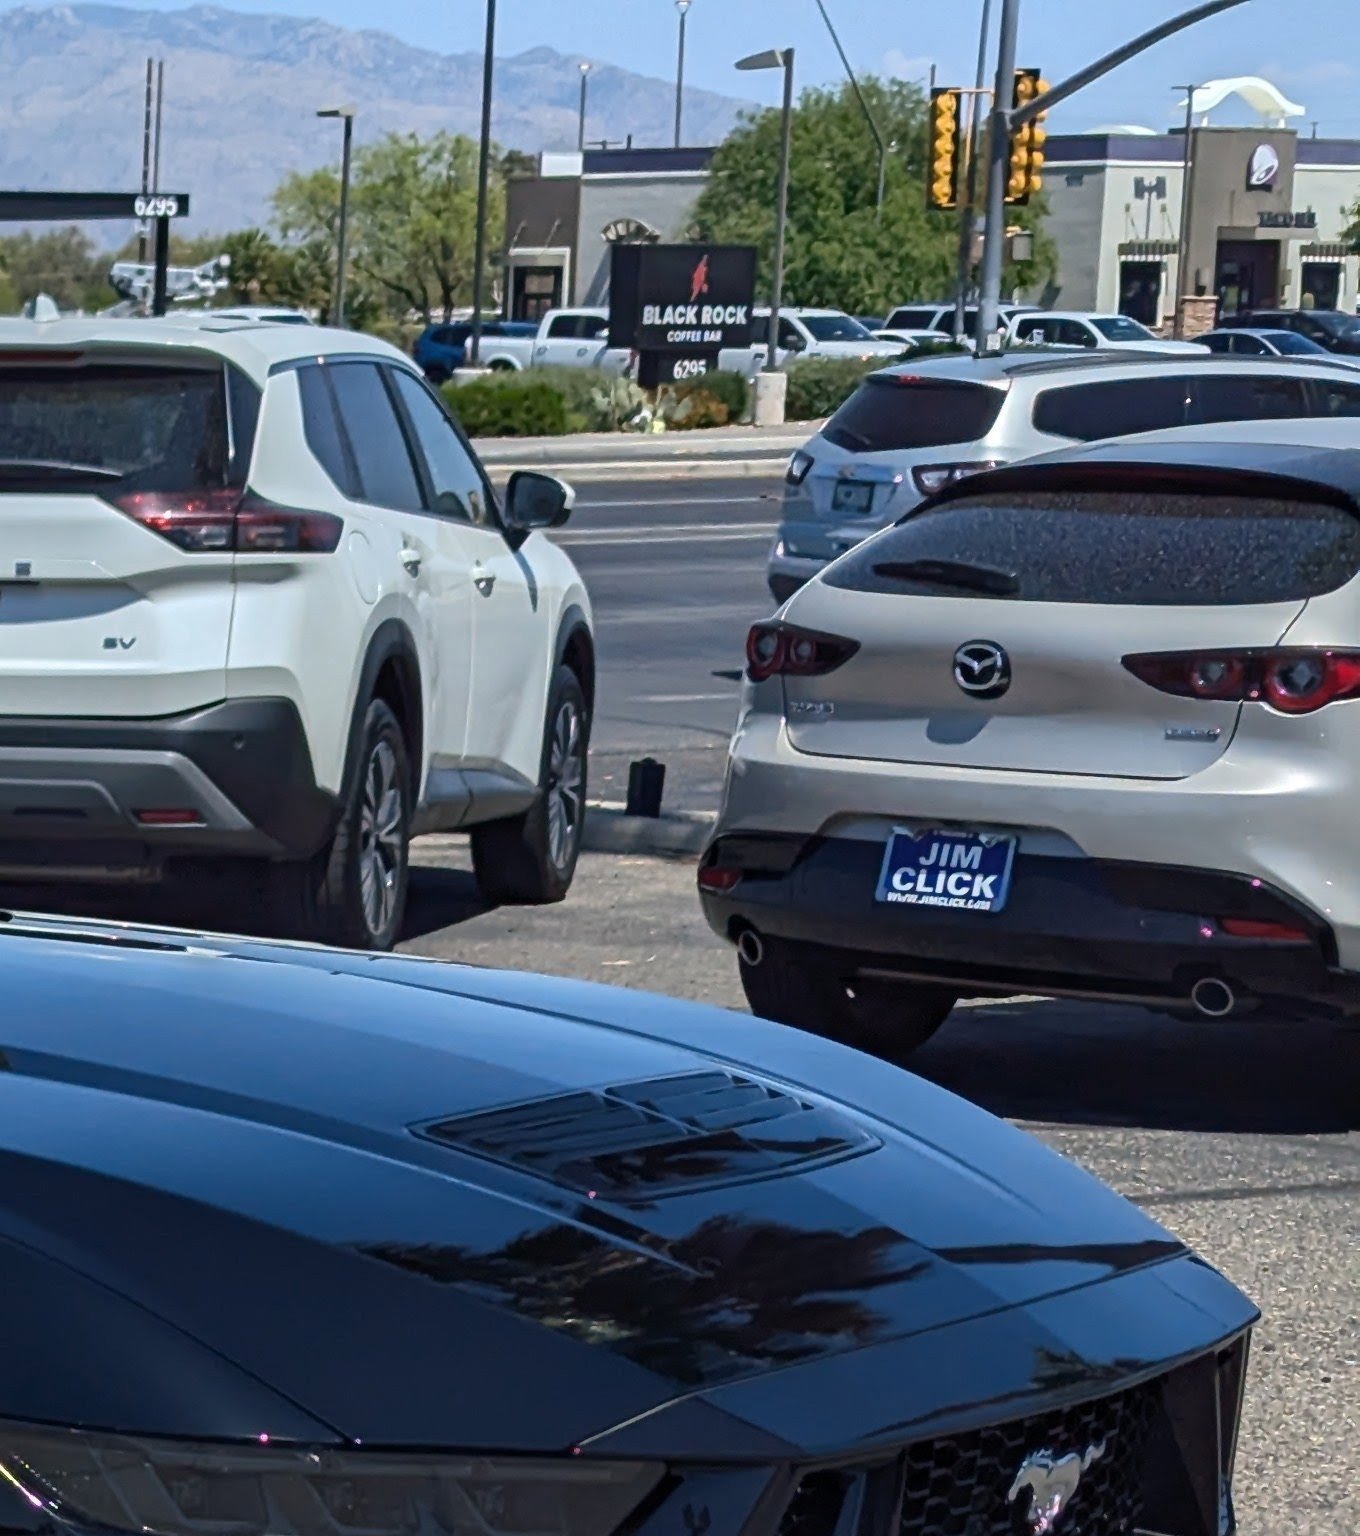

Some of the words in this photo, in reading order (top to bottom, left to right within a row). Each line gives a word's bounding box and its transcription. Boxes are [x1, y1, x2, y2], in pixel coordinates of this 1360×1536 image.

[134, 195, 179, 216] 6295
[642, 304, 698, 325] BLACK
[701, 305, 747, 325] ROCK
[667, 330, 701, 342] COFFEE
[703, 330, 723, 341] BAR
[673, 359, 707, 379] 6295
[918, 842, 983, 870] JIM
[892, 867, 998, 899] CLICK
